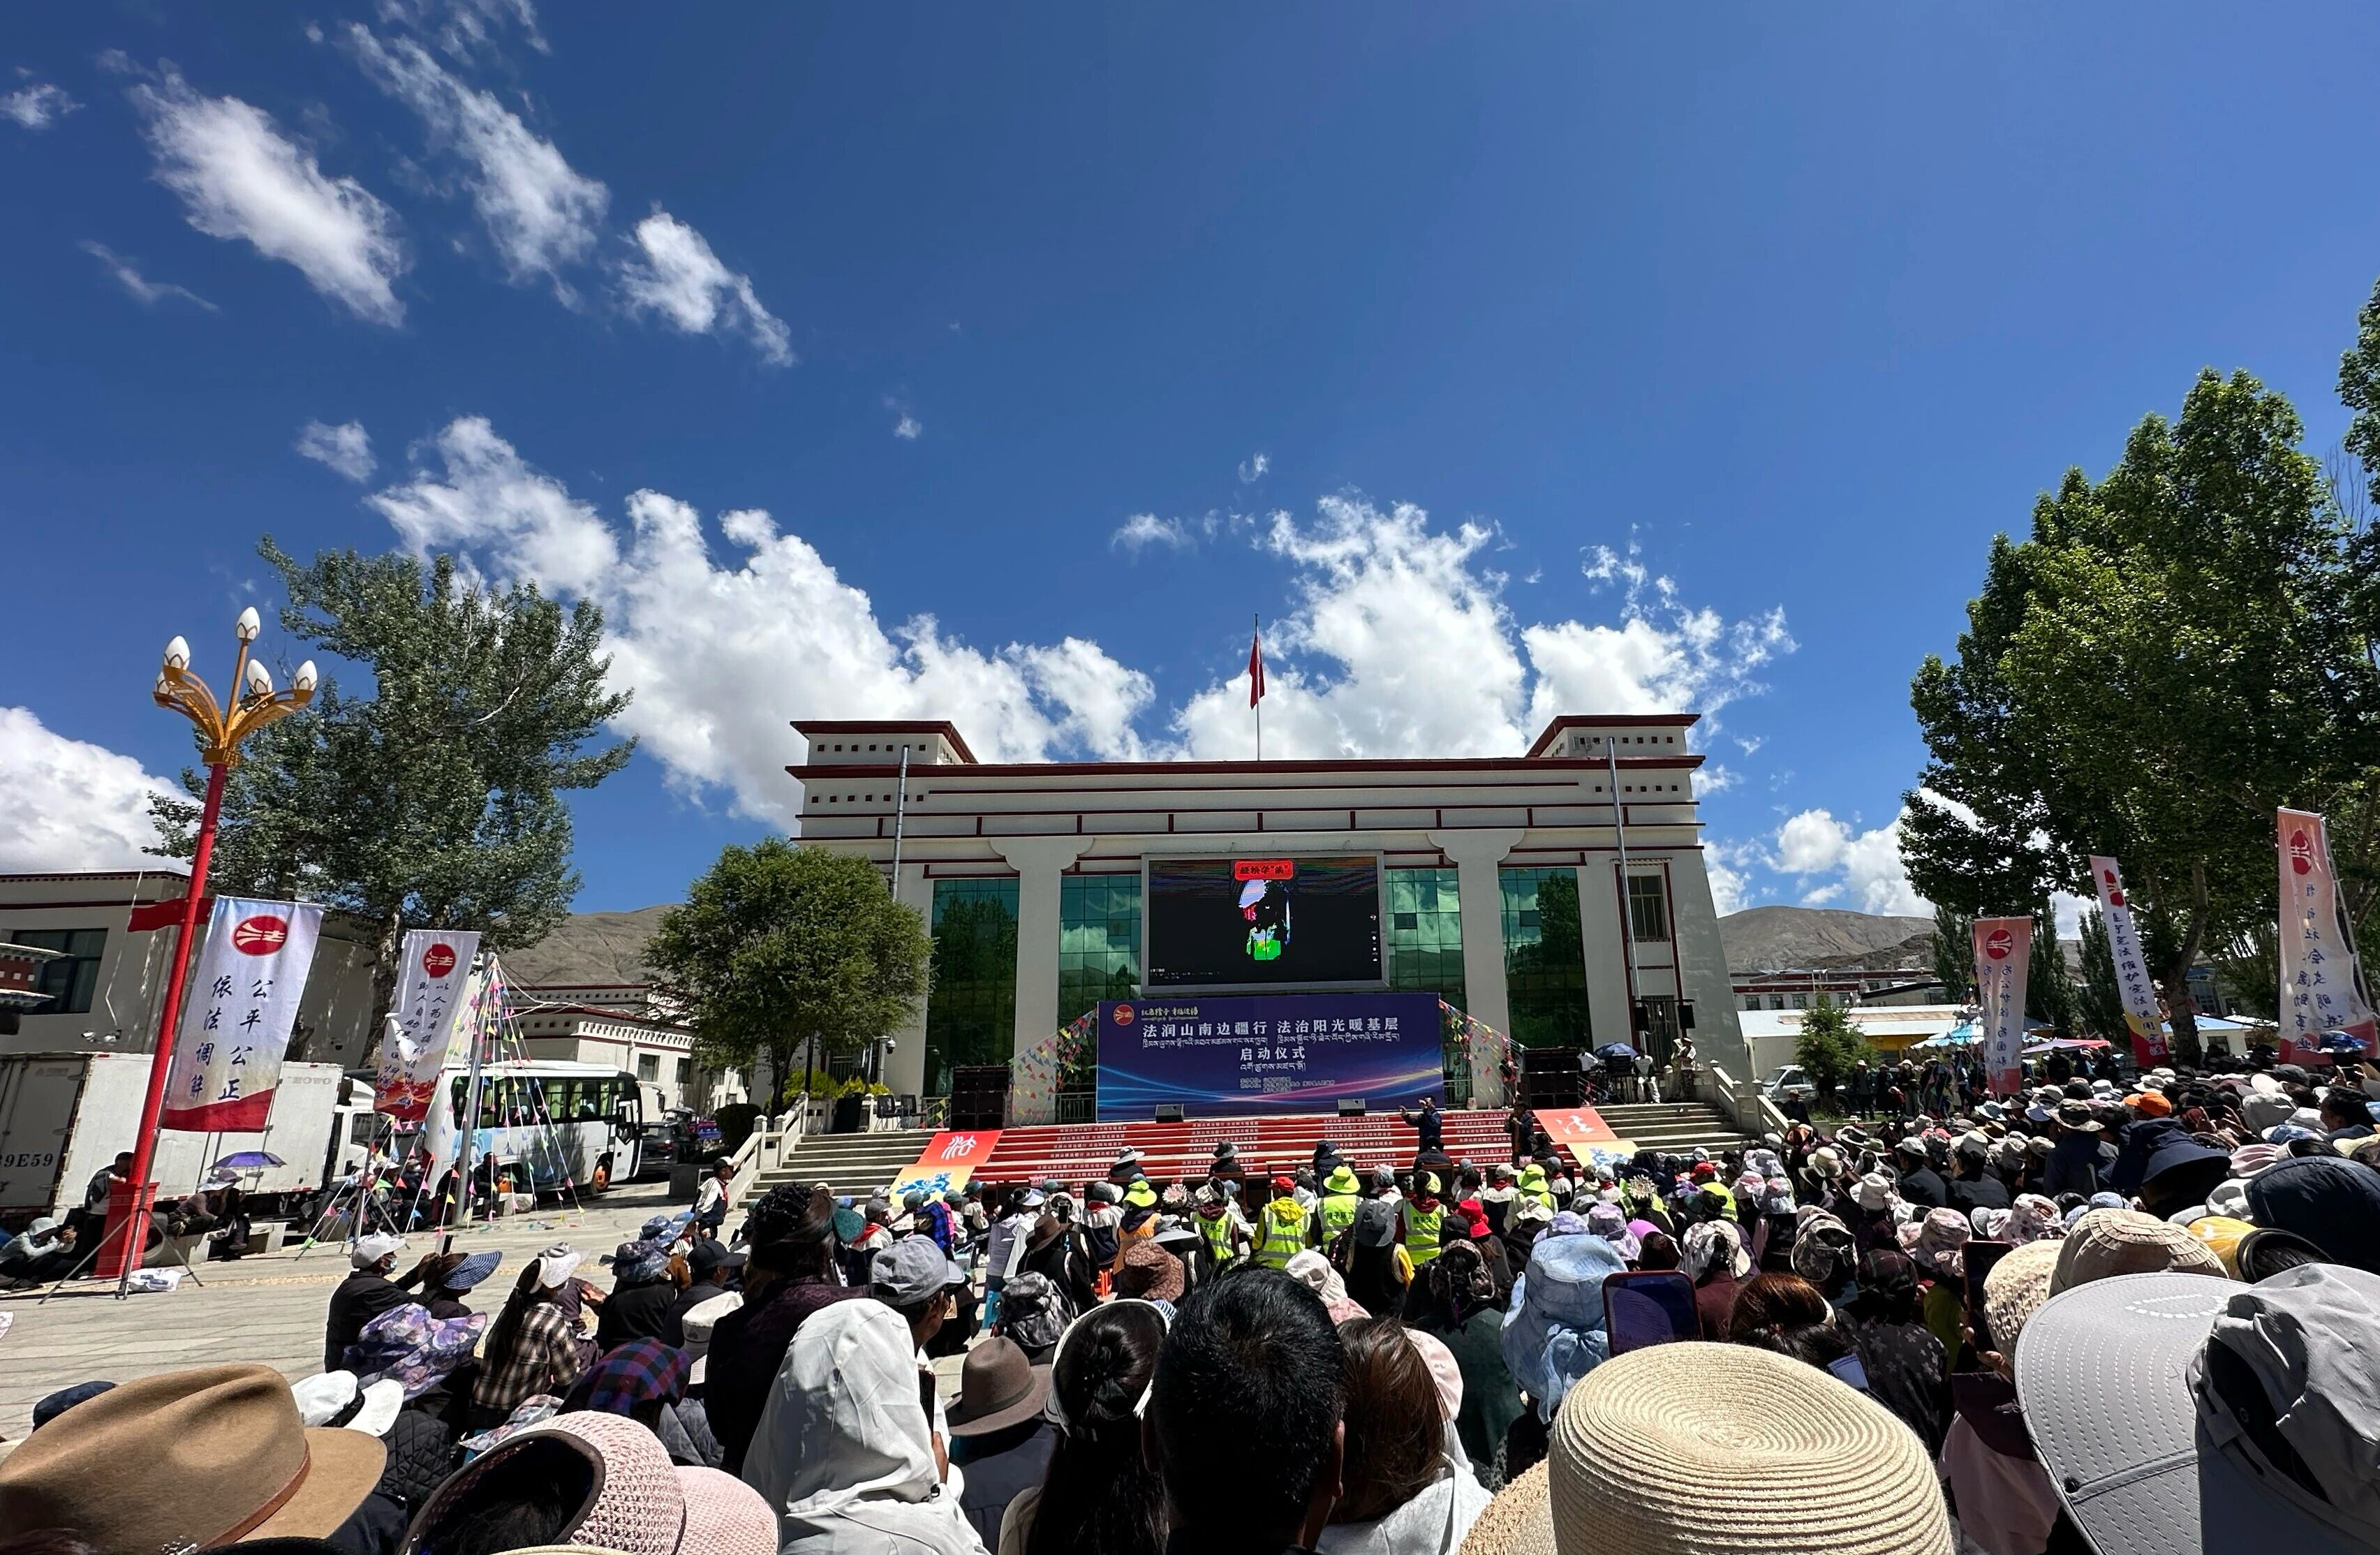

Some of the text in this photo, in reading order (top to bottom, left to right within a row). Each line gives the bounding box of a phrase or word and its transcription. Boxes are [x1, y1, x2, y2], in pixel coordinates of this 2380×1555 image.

[190, 975, 232, 1099] 依法调解
[218, 978, 274, 1100] 公平公正
[1143, 1017, 1398, 1038] 法润山南边疆行 法治阳光暖基层
[1240, 1046, 1306, 1061] 启动仪式
